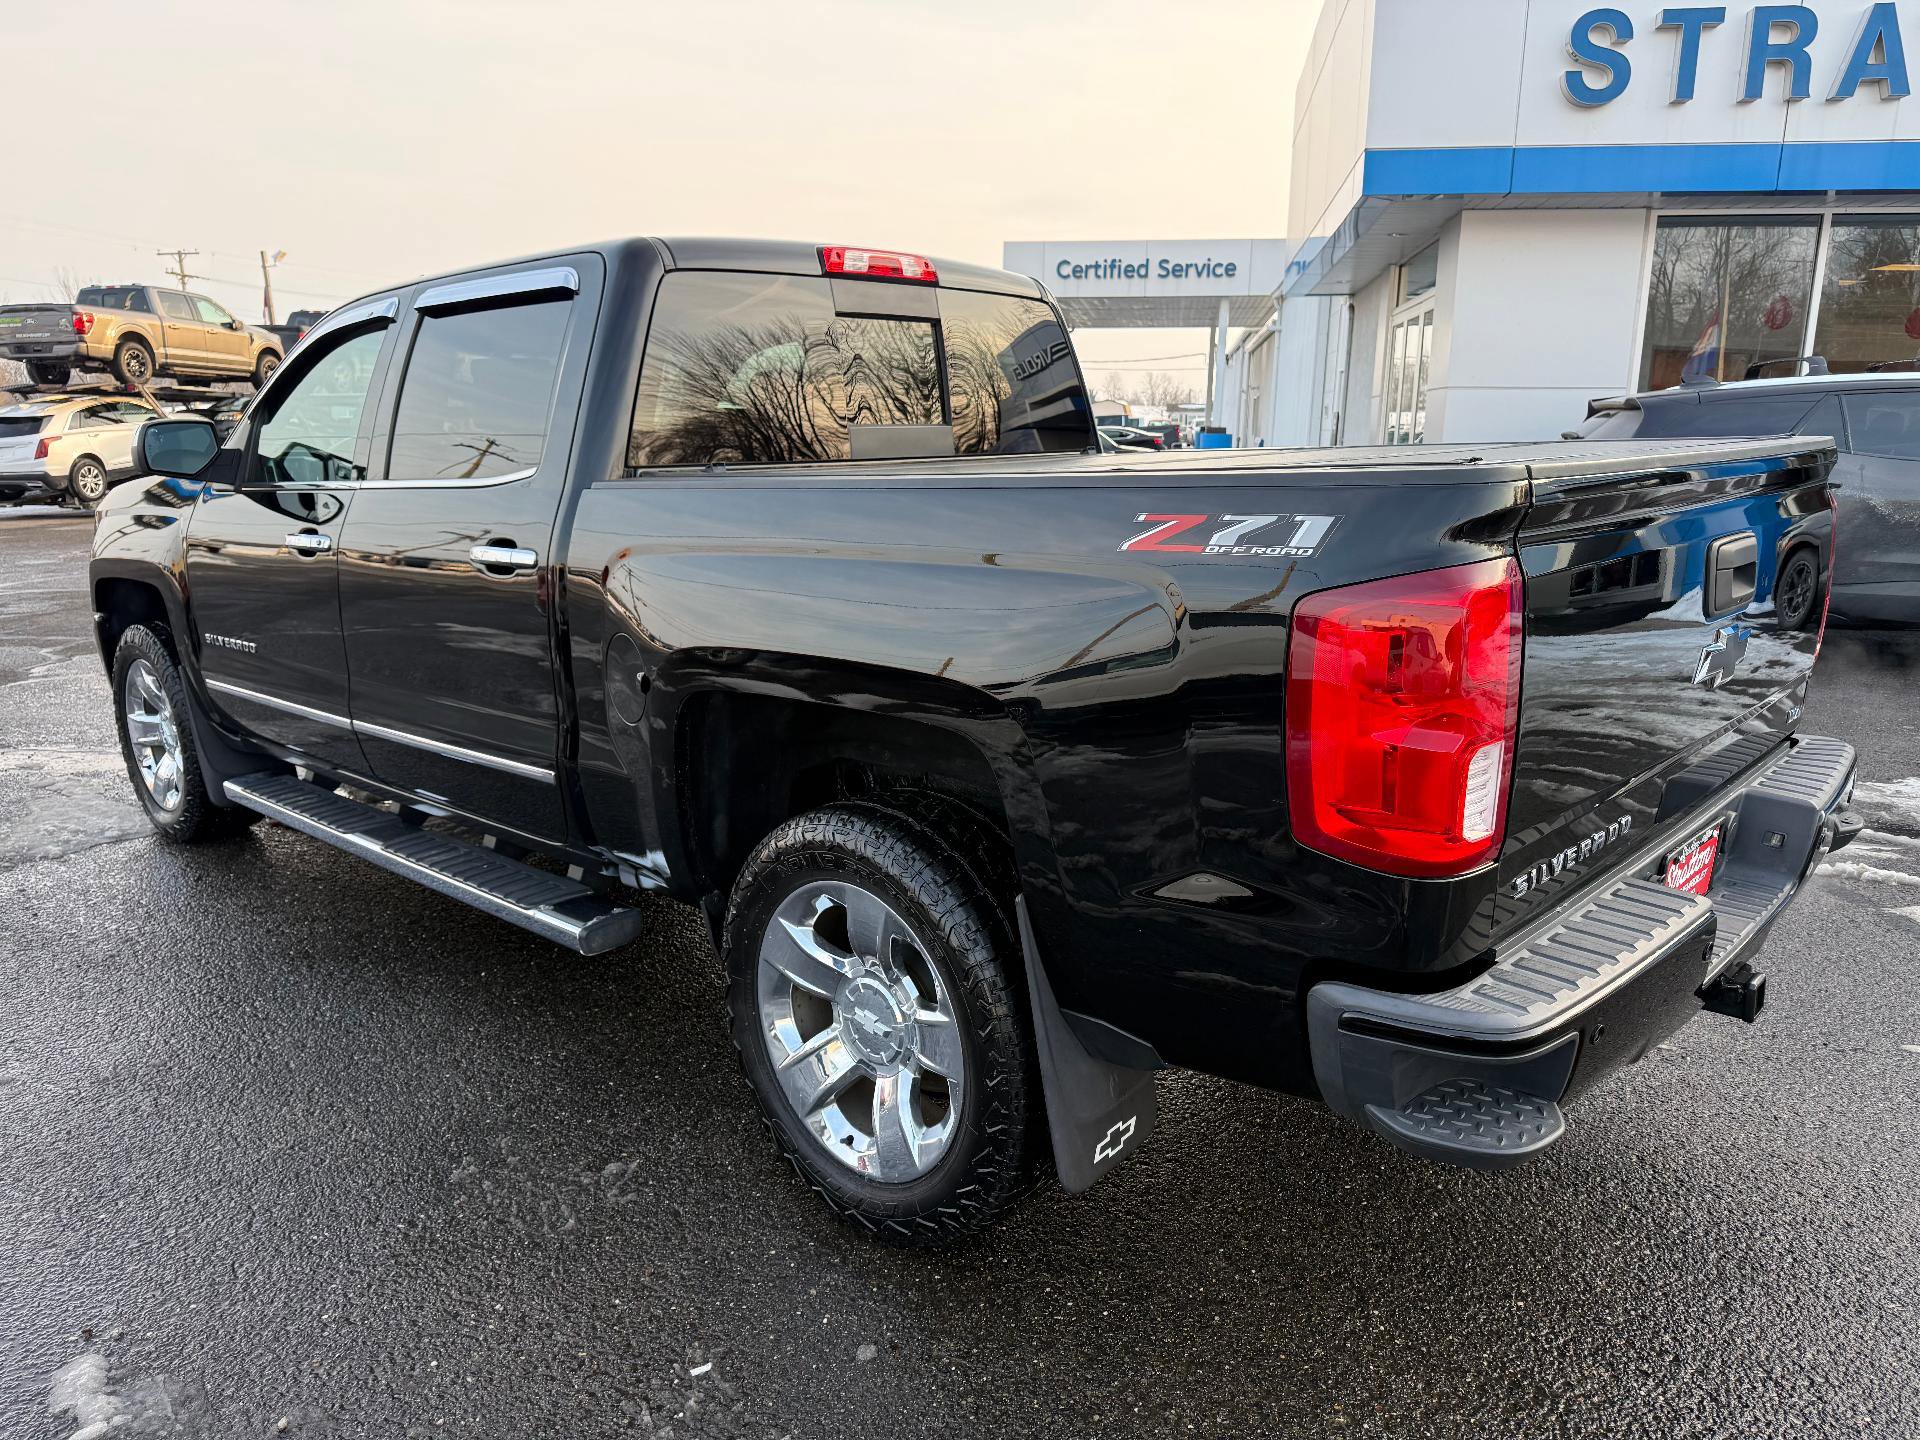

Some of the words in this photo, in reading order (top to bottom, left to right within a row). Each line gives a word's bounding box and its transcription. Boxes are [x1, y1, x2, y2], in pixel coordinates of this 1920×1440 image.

[1559, 2, 1911, 108] STRA
[1056, 258, 1149, 280] Certified
[1157, 257, 1237, 279] Service
[1117, 513, 1345, 557] Z71
[1204, 546, 1247, 555] OFF
[1250, 546, 1315, 557] ROAD
[204, 632, 257, 654] SILVERADO
[1510, 814, 1631, 900] SILVERADO
